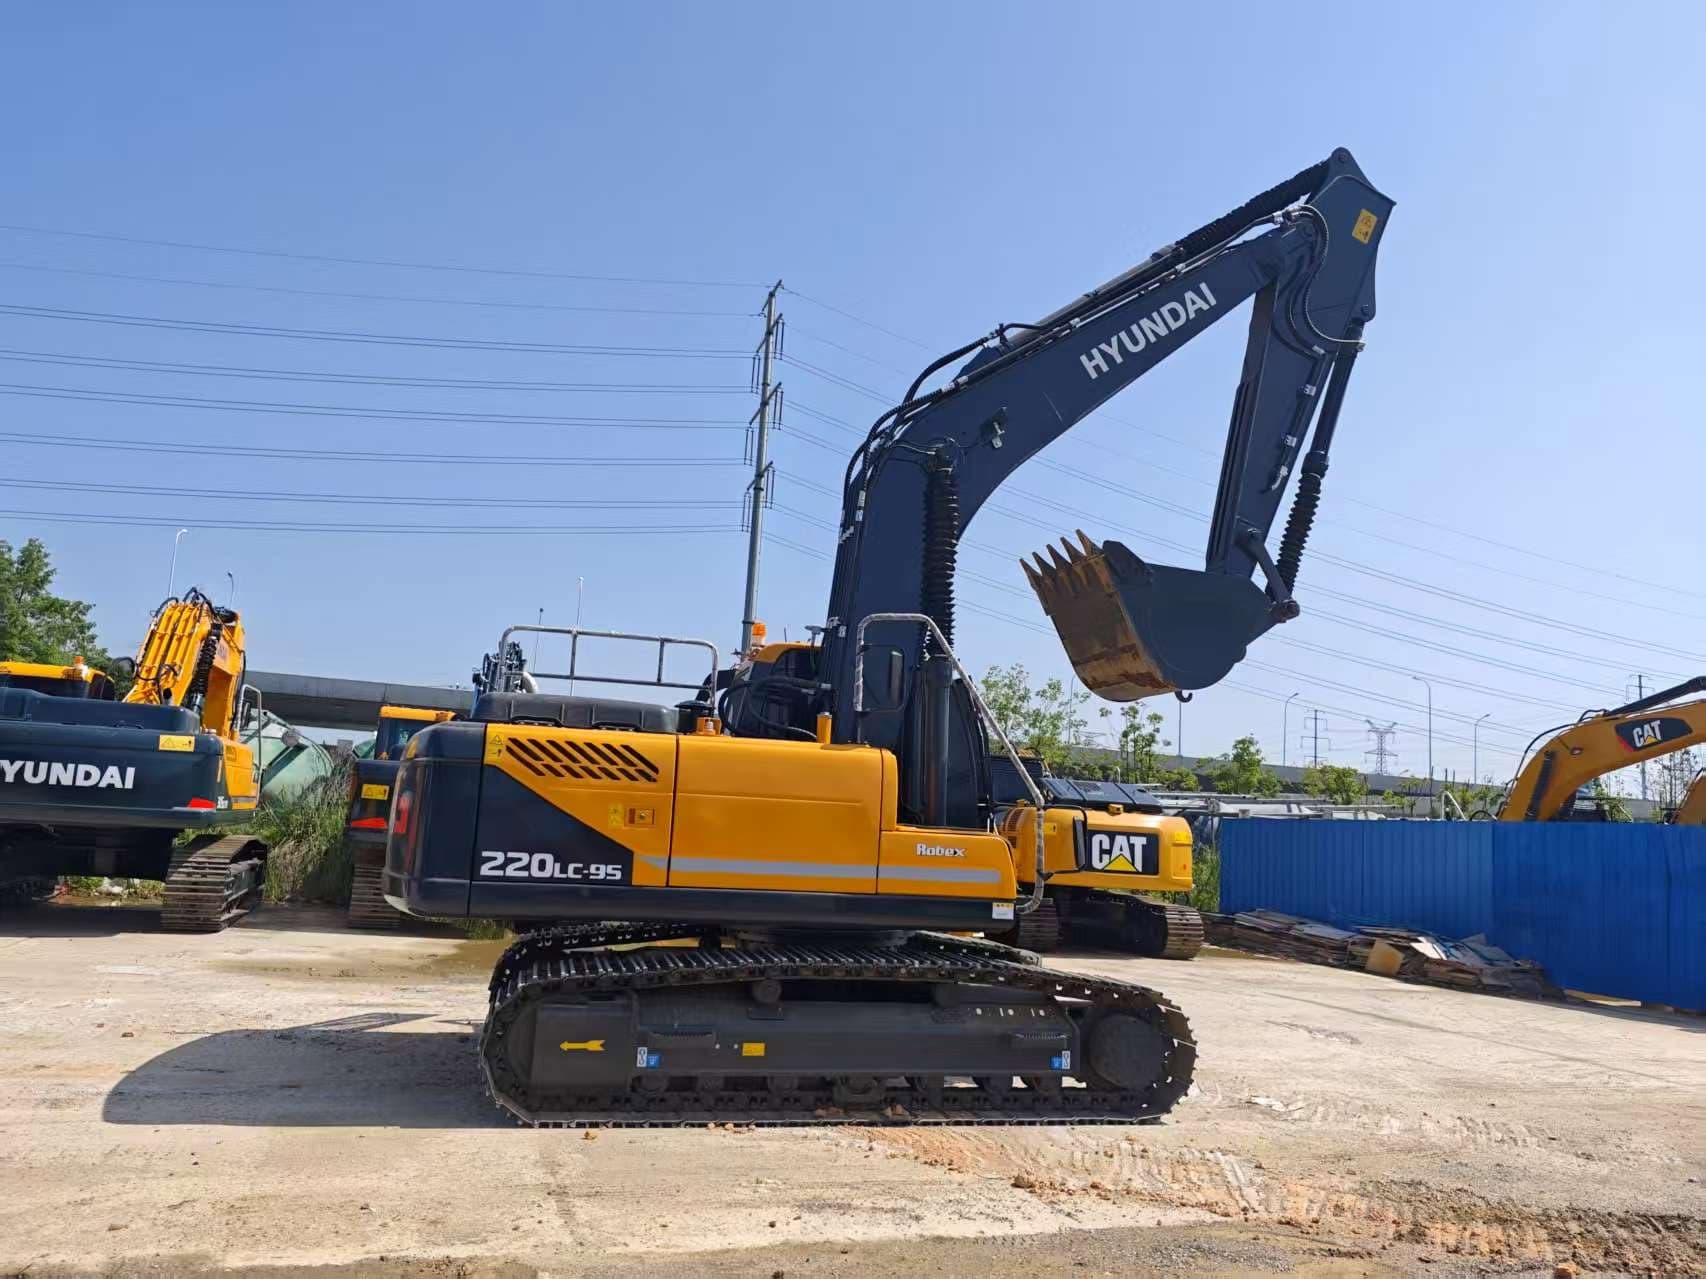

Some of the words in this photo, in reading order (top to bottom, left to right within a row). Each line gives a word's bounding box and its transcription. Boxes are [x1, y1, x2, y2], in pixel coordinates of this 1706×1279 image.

[1079, 282, 1217, 380] HYUNDAI
[1632, 719, 1662, 748] CAT
[0, 759, 136, 789] YUNDAI
[916, 843, 966, 857] Robex
[1091, 833, 1147, 873] CAT
